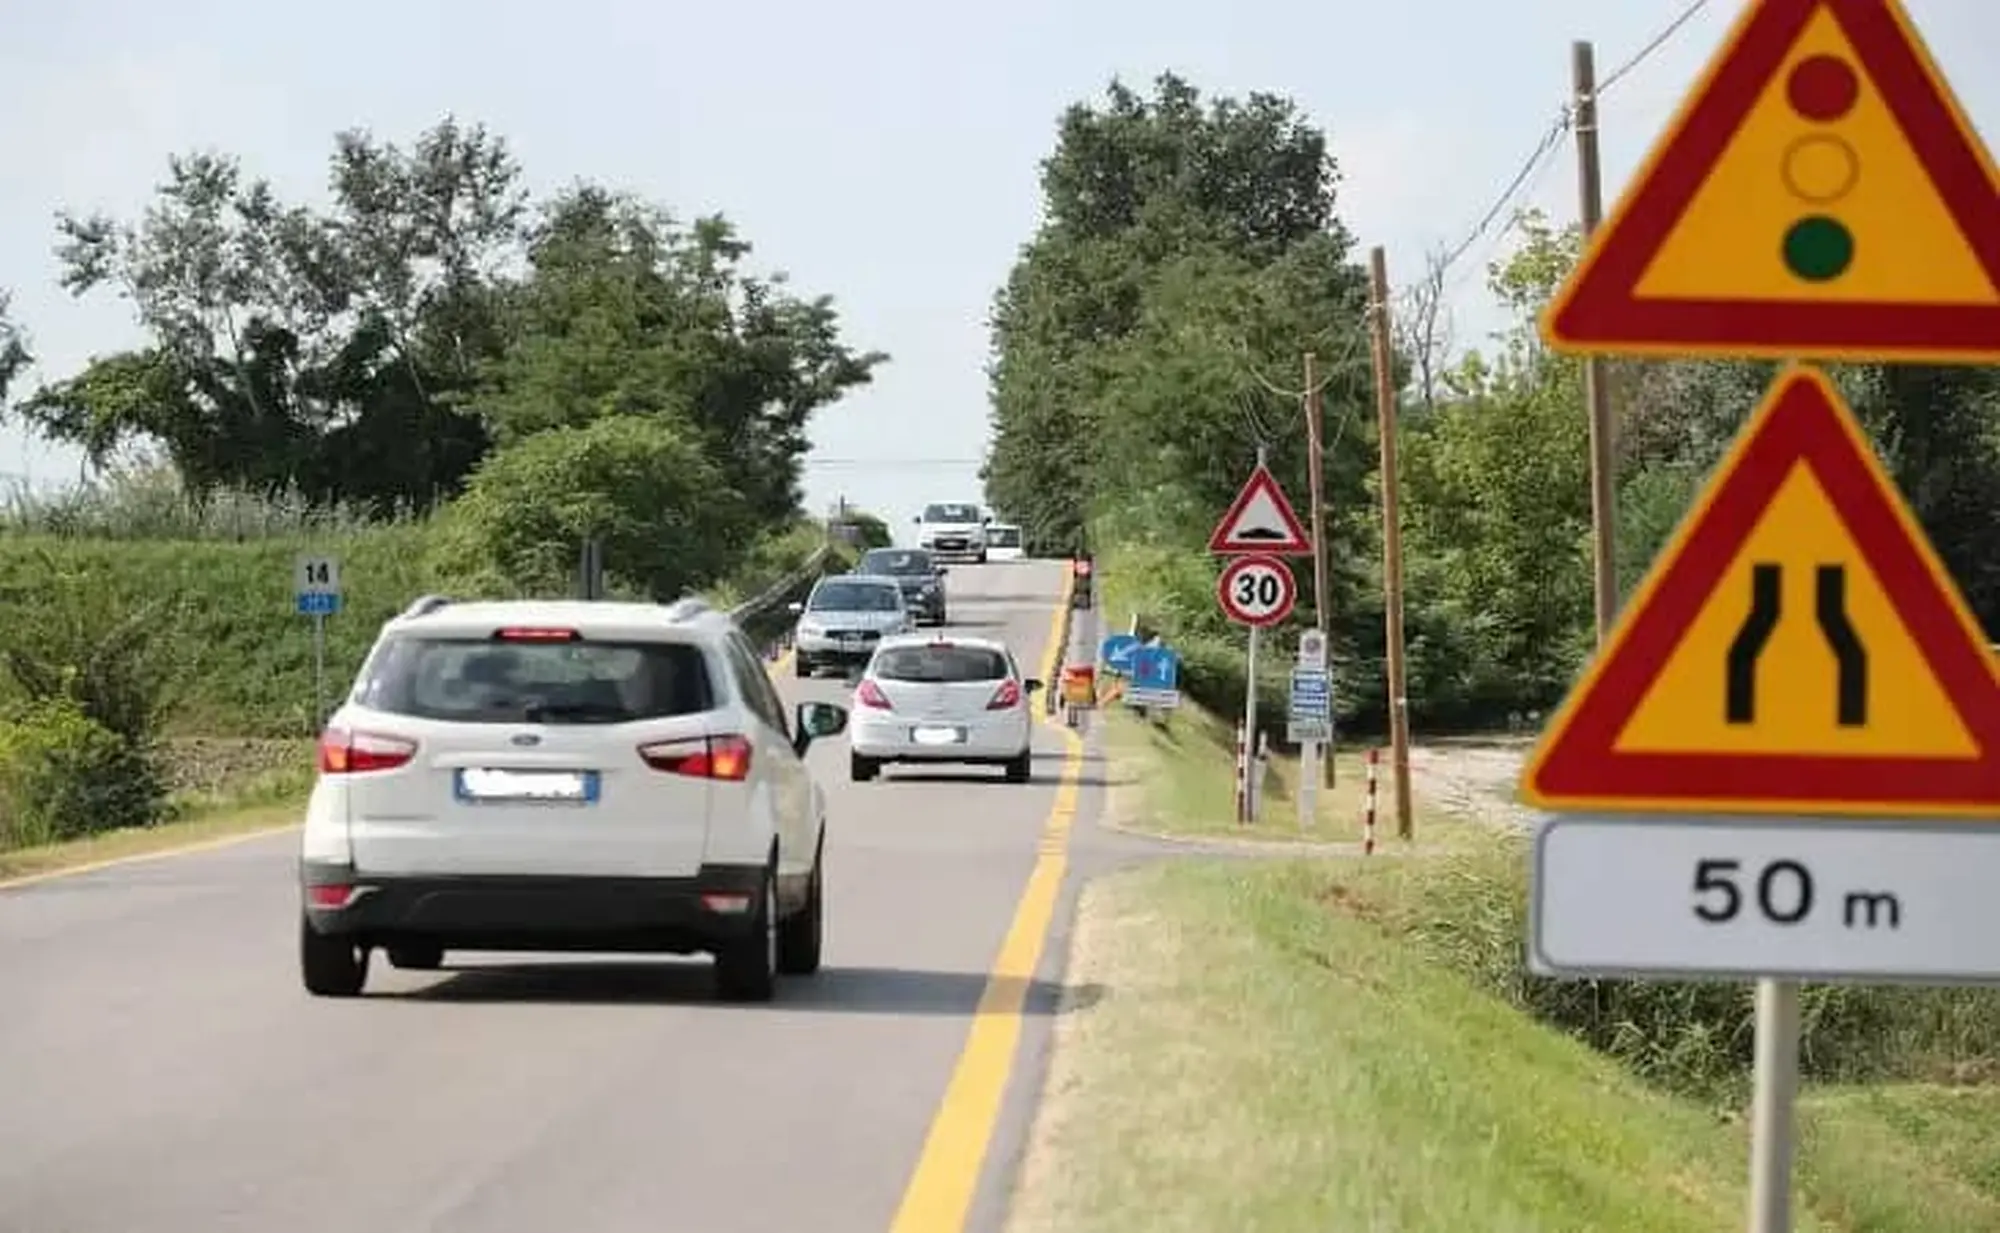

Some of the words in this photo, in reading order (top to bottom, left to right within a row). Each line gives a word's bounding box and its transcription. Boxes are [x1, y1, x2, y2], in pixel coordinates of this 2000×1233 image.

[305, 562, 329, 584] 14
[1237, 573, 1279, 606] 30
[1692, 858, 1814, 926] 50
[1843, 891, 1901, 928] m
